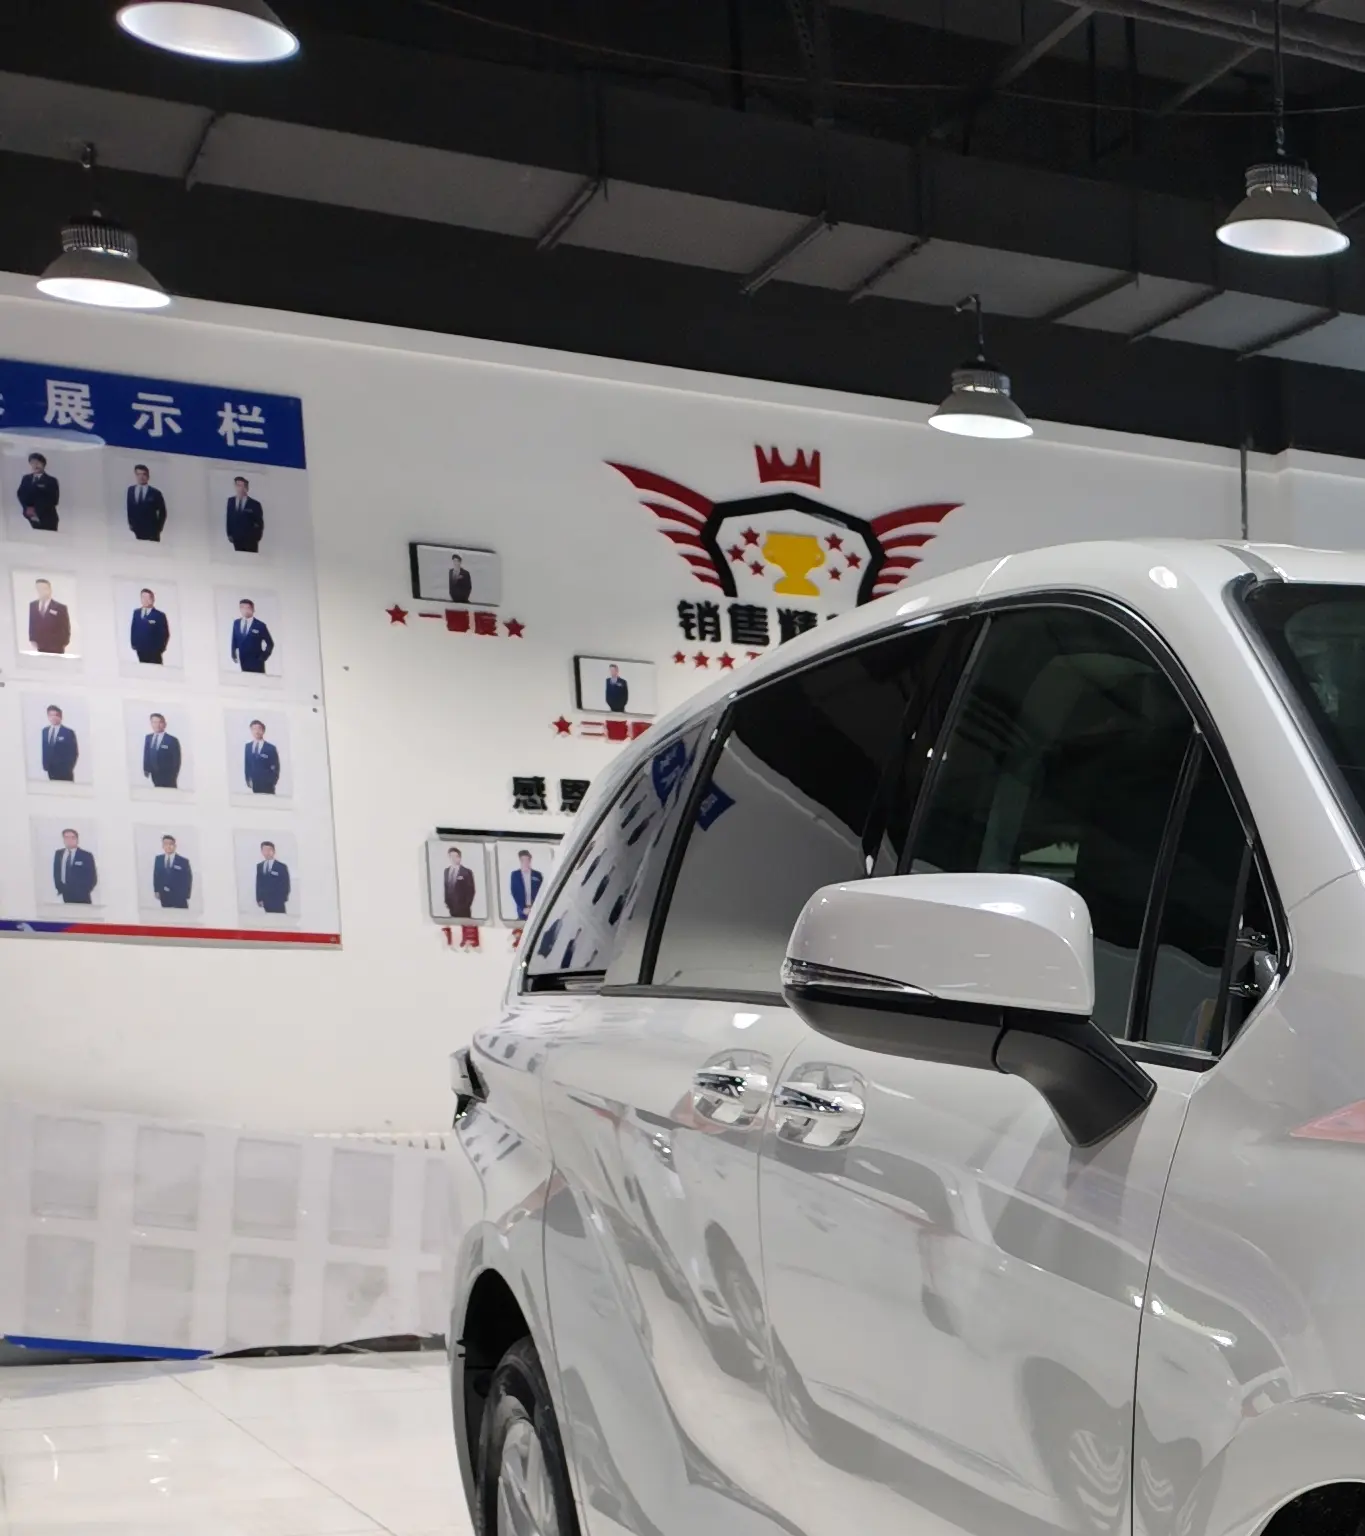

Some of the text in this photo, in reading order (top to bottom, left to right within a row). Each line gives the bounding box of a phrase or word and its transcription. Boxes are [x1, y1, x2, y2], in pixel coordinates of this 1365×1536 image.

[0, 379, 269, 449] 展示栏
[676, 599, 844, 646] 销售精
